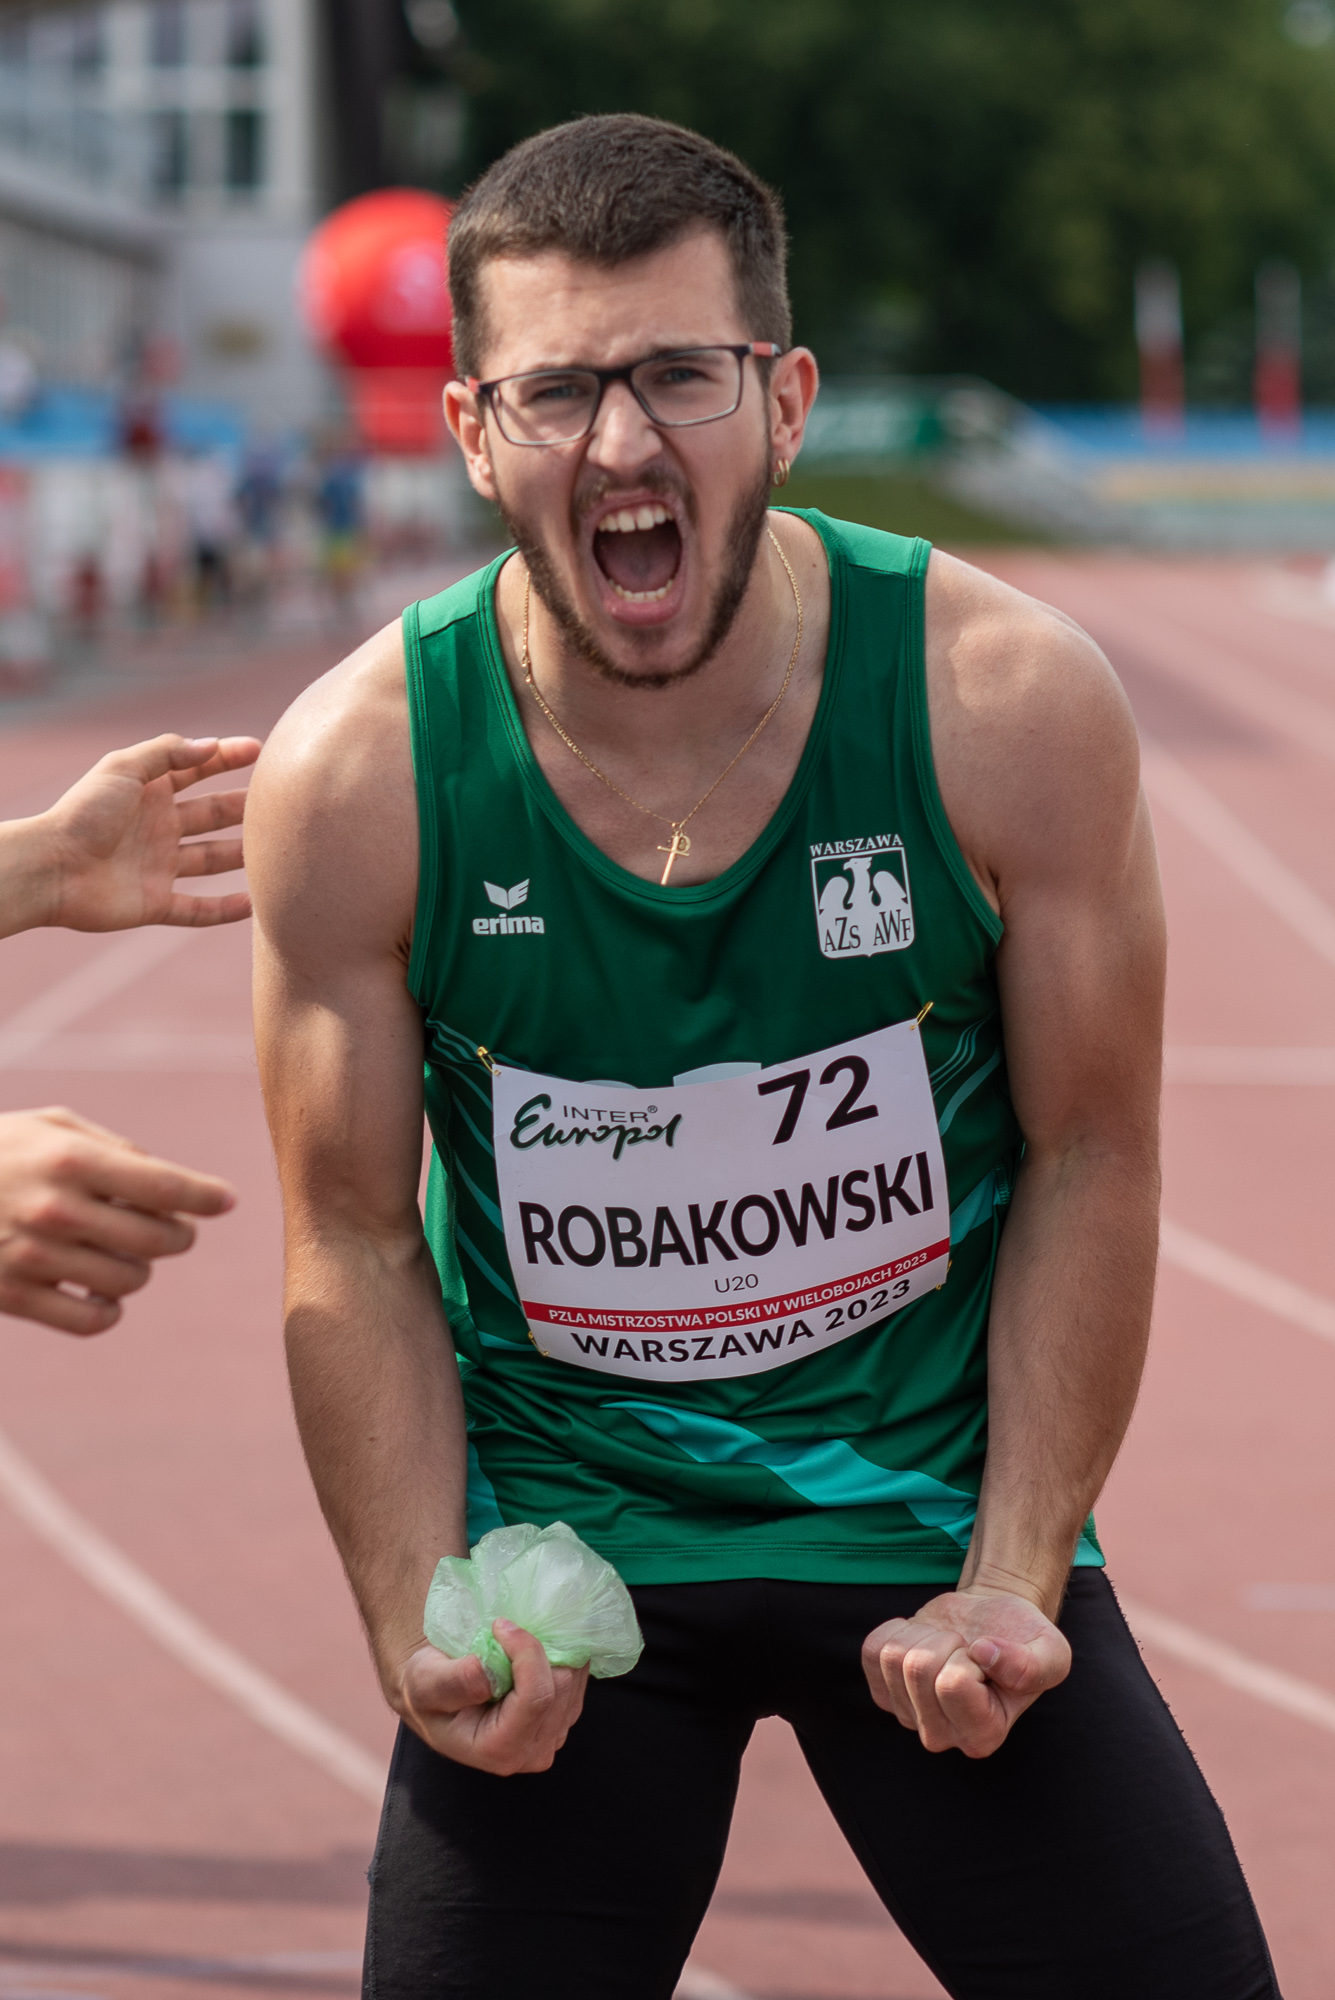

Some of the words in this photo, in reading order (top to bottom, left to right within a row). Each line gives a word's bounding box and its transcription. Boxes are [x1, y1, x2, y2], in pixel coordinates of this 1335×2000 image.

[809, 833, 904, 857] WARSZAWA
[472, 913, 545, 935] erima
[824, 916, 861, 952] AZS
[873, 909, 911, 946] AWF
[509, 1093, 683, 1161] Europol
[757, 1055, 879, 1145] 72
[518, 1151, 935, 1268] ROBAKOWSKI
[548, 1309, 587, 1325] PZLA
[588, 1313, 703, 1328] MISTRZOSTWA
[705, 1306, 761, 1325] POLSKI
[764, 1301, 785, 1315] W
[783, 1267, 892, 1311] WIELOBOJACH
[895, 1252, 928, 1274] 2023
[714, 1273, 759, 1293] U20
[570, 1319, 815, 1363] WARSZAWA
[824, 1279, 911, 1332] 2023
